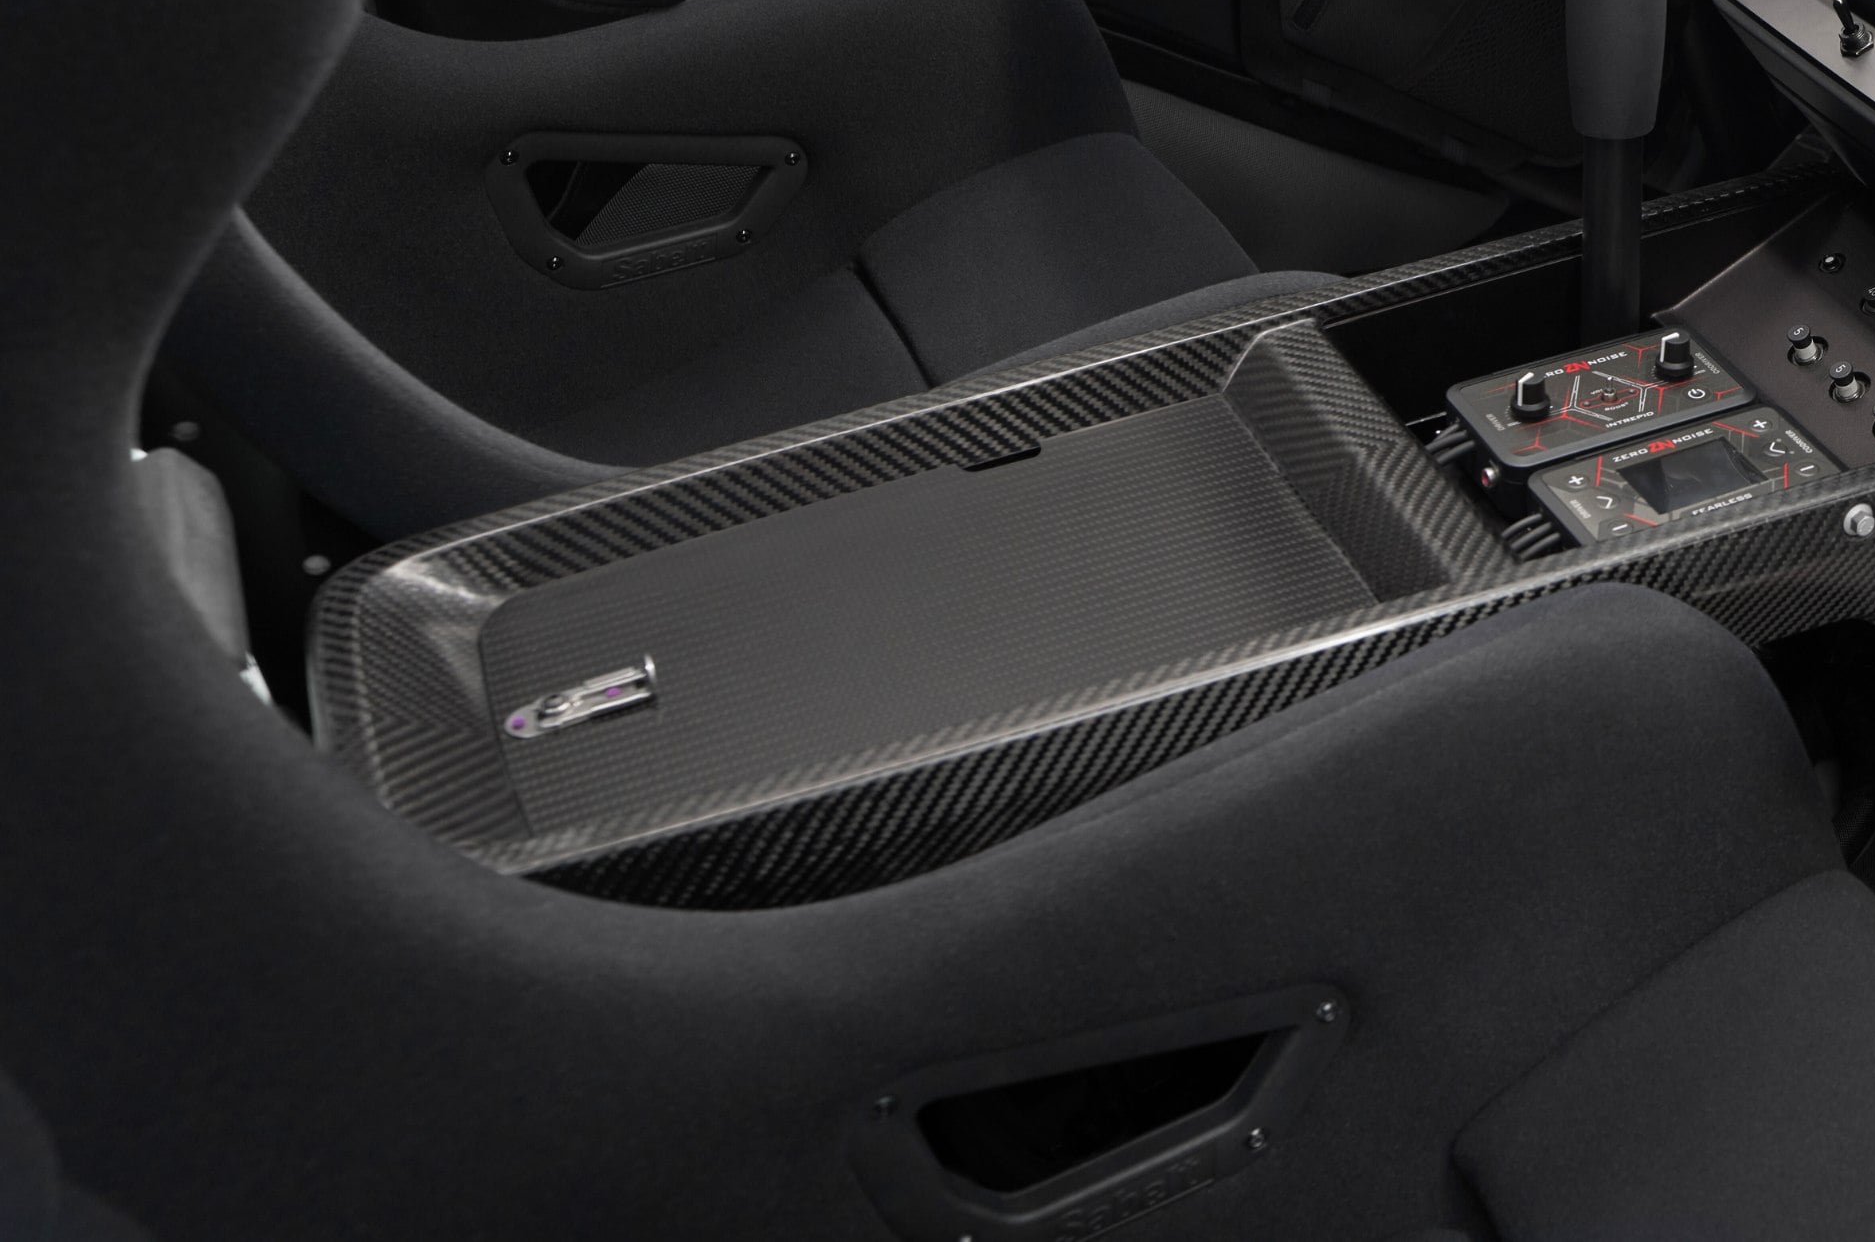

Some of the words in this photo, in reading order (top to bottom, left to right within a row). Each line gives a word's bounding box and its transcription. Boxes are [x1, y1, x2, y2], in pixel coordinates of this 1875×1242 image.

[1794, 328, 1804, 336] 5
[1587, 351, 1628, 366] NOISE
[1835, 364, 1846, 373] 5
[1606, 411, 1654, 428] INTREPID
[1612, 448, 1648, 463] ZERO
[1672, 428, 1714, 445] NOISE
